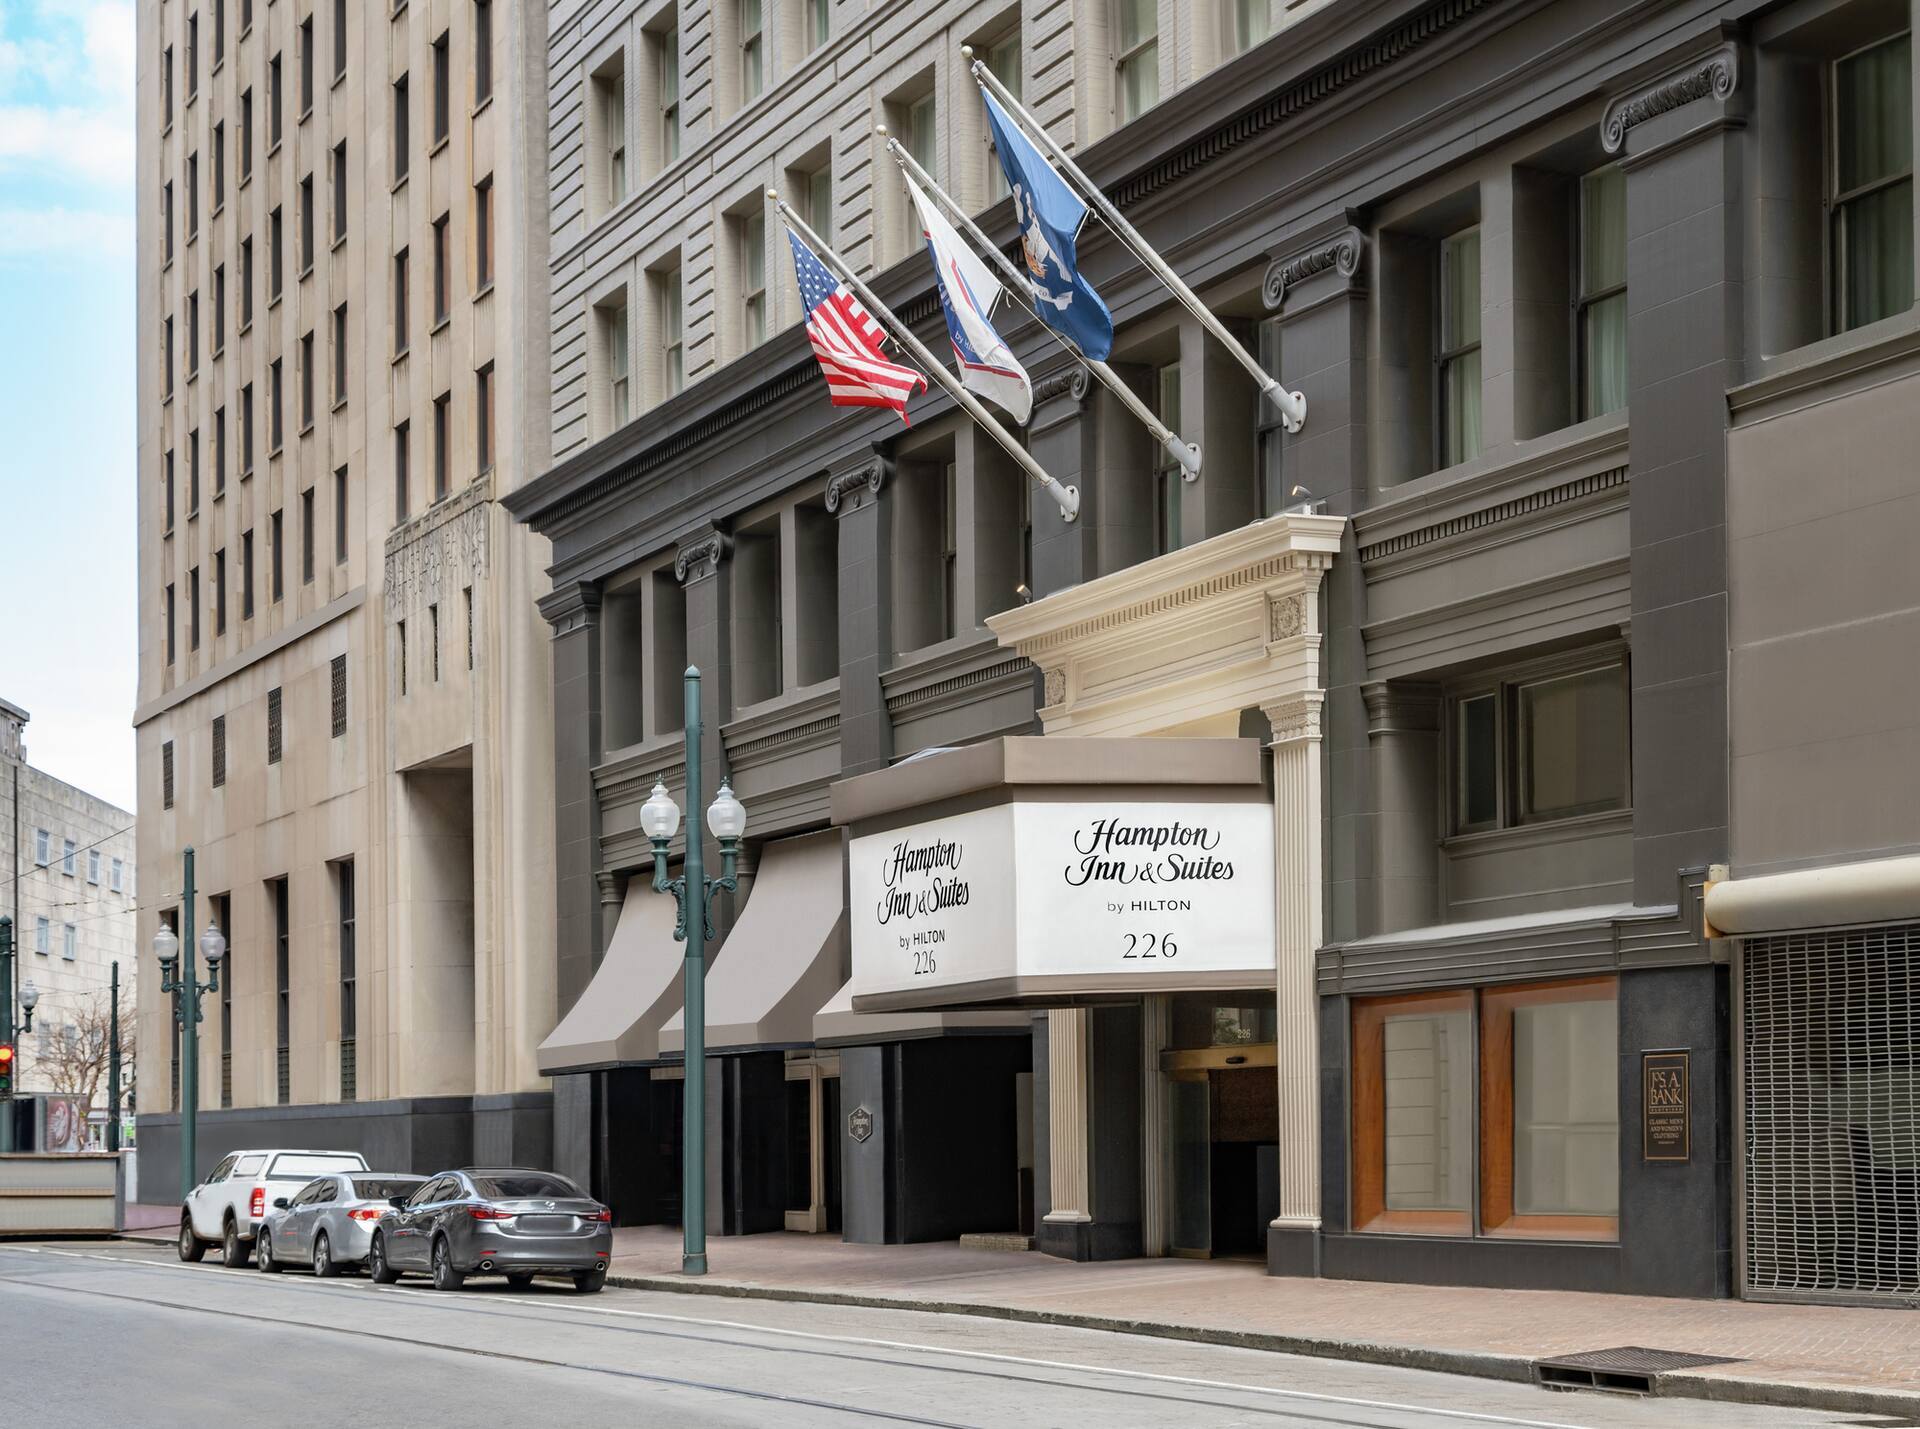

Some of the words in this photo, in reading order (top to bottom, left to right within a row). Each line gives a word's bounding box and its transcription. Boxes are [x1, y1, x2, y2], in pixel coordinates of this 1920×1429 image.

[1074, 817, 1220, 855] Hampton
[882, 838, 963, 887] Hampton
[1065, 854, 1139, 887] Inn
[1139, 862, 1158, 884] &
[1157, 853, 1234, 882] Suites
[876, 887, 919, 926] Inn
[918, 889, 929, 917] &
[927, 876, 970, 912] Suites
[1107, 901, 1124, 915] by
[1131, 900, 1191, 912] HILTON
[899, 935, 910, 951] by
[913, 929, 945, 946] HILTON
[1123, 932, 1178, 958] 226
[913, 950, 937, 975] 226
[1237, 1028, 1251, 1039] 226
[1651, 1088, 1682, 1105] BANK
